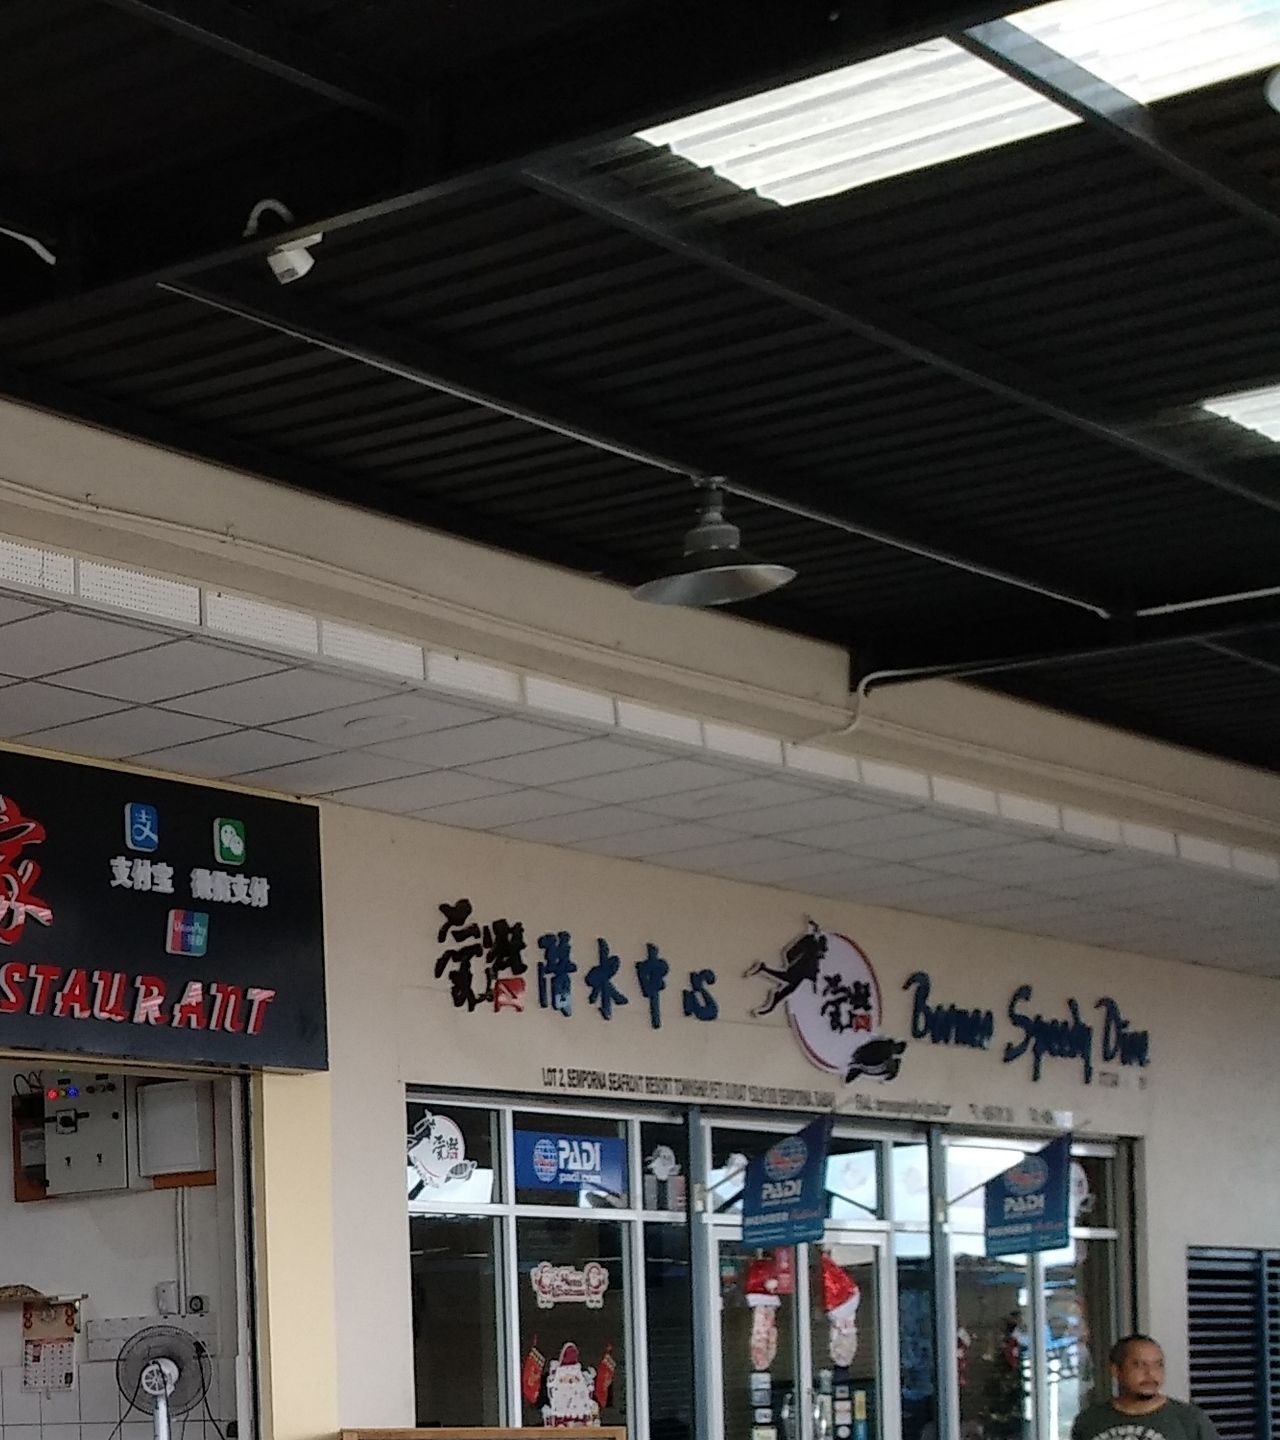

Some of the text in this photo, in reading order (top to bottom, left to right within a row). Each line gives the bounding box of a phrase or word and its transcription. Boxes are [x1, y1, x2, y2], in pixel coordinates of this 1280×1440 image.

[109, 855, 175, 894] 支付宝
[558, 1139, 602, 1172] PADI
